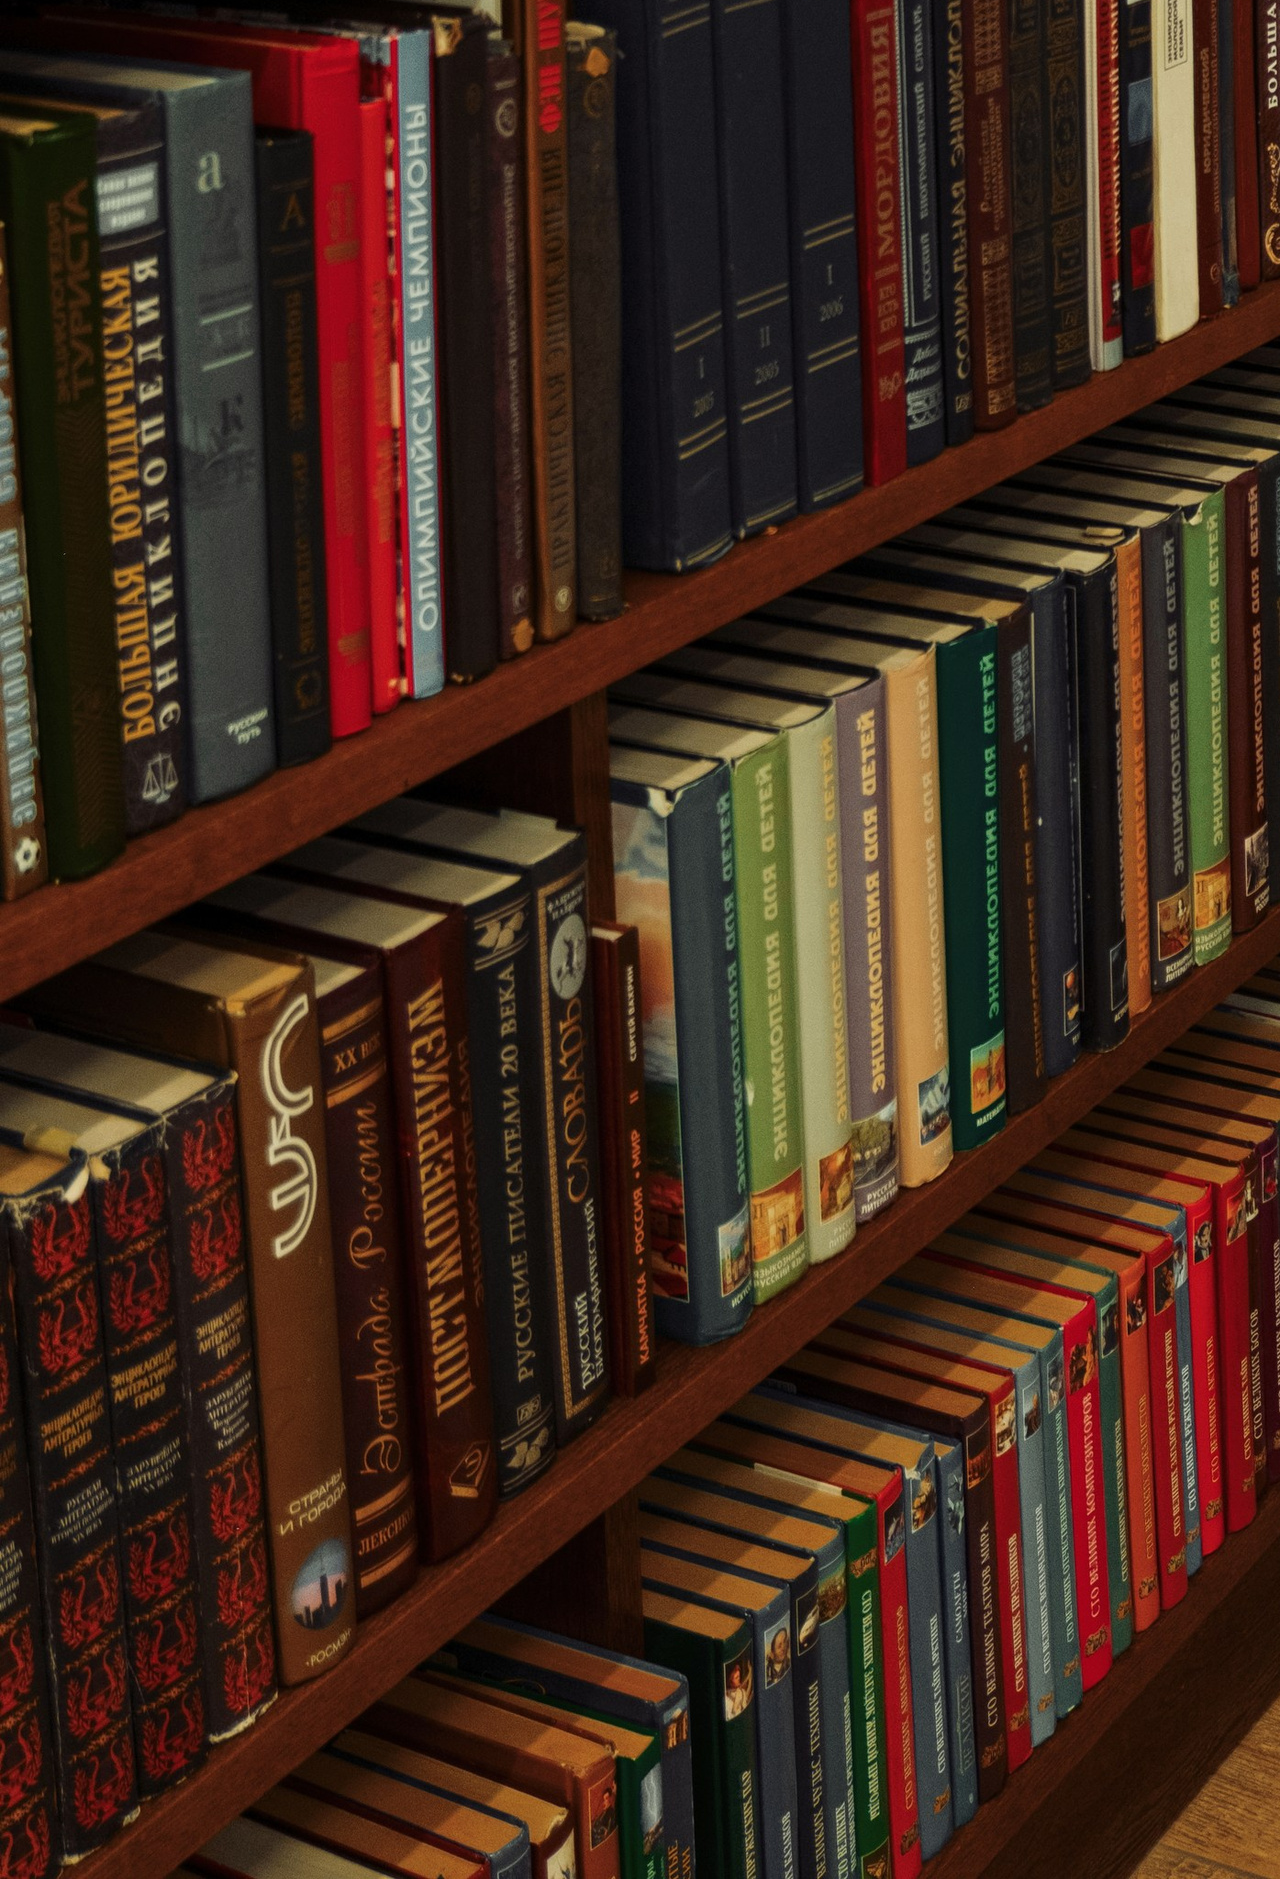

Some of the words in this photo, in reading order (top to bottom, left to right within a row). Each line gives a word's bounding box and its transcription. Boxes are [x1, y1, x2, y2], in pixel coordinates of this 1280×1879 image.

[912, 4, 925, 74] СЛОВАРЬ
[1172, 0, 1180, 61] МОЛОДОЙ
[870, 22, 898, 258] МОРДОВИЯ
[1200, 47, 1213, 175] ЮРИДИЧЕСКИЙ
[915, 81, 930, 220] БИОГРАФИЧЕСКИЙ
[404, 102, 431, 321] ЧЕМПИОНЫ
[62, 178, 95, 399] ТУРИСТА
[920, 231, 932, 302] РУССКИЙ
[950, 179, 972, 381] СОЦИАЛЬНАЯ
[98, 264, 143, 545] ЮРИДИЧЕСКАЯ
[133, 254, 180, 733] ЭНЦИКЛОПЕДИЯ
[408, 336, 439, 632] ОЛИМПИЙСКИЕ
[112, 561, 157, 744] БОЛЬШАЯ
[978, 652, 996, 735] ДЕТЕЙ
[856, 708, 877, 797] ДЕТЕЙ
[983, 745, 998, 798] ДЛЯ
[755, 762, 776, 853] ДЕТЕЙ
[862, 805, 880, 862] ДЛЯ
[761, 864, 780, 922] ДЛЯ
[983, 807, 1001, 1020] ЭНЦИКЛОПЕДИЯ
[498, 961, 518, 1038] ВЕКА
[864, 871, 888, 1095] ЭНЦИКЛОПЕДИЯ
[333, 1046, 358, 1074] XX
[500, 1042, 520, 1078] 20
[627, 1017, 638, 1062] СЕРГЕЙ
[764, 931, 789, 1162] ЭНЦИКЛОПЕДИЯ
[558, 997, 591, 1204] СЛОВАРЬ
[348, 1100, 387, 1270] России
[501, 1085, 528, 1245] ПИСАТЕЛИ
[629, 1129, 642, 1169] МИР
[406, 976, 477, 1418] ПОСТМОДЕРНИЗМ
[632, 1186, 647, 1255] РОССИЯ
[509, 1250, 537, 1382] РУССКИЕ
[573, 1291, 596, 1390] РУССКИЙ
[635, 1270, 651, 1365] КАМЧАТКА
[355, 1286, 401, 1475] Эстрада
[1081, 1391, 1097, 1516] КОМПОЗИТОРОВ
[279, 1522, 295, 1537] И
[299, 1482, 348, 1528] ГОРОДА
[288, 1471, 343, 1516] СТРАНЫ
[979, 1521, 991, 1564] МИРА
[1086, 1517, 1100, 1584] ВЕЛИКИХ
[861, 1589, 872, 1612] СТО
[980, 1564, 996, 1630] ТЕАТРОВ
[1089, 1586, 1102, 1619] СТО
[861, 1612, 874, 1670] ВЕЛИКИХ
[983, 1633, 998, 1694] ВЕЛИКИХ
[808, 1679, 820, 1756] ТЕХНИКИ
[862, 1670, 876, 1720] ЗАГАДОК
[985, 1696, 1000, 1728] СТО
[865, 1720, 879, 1761] ЖИВОЙ
[810, 1754, 824, 1808] ЧУДЕС
[866, 1761, 880, 1822] ПРИРОДЫ
